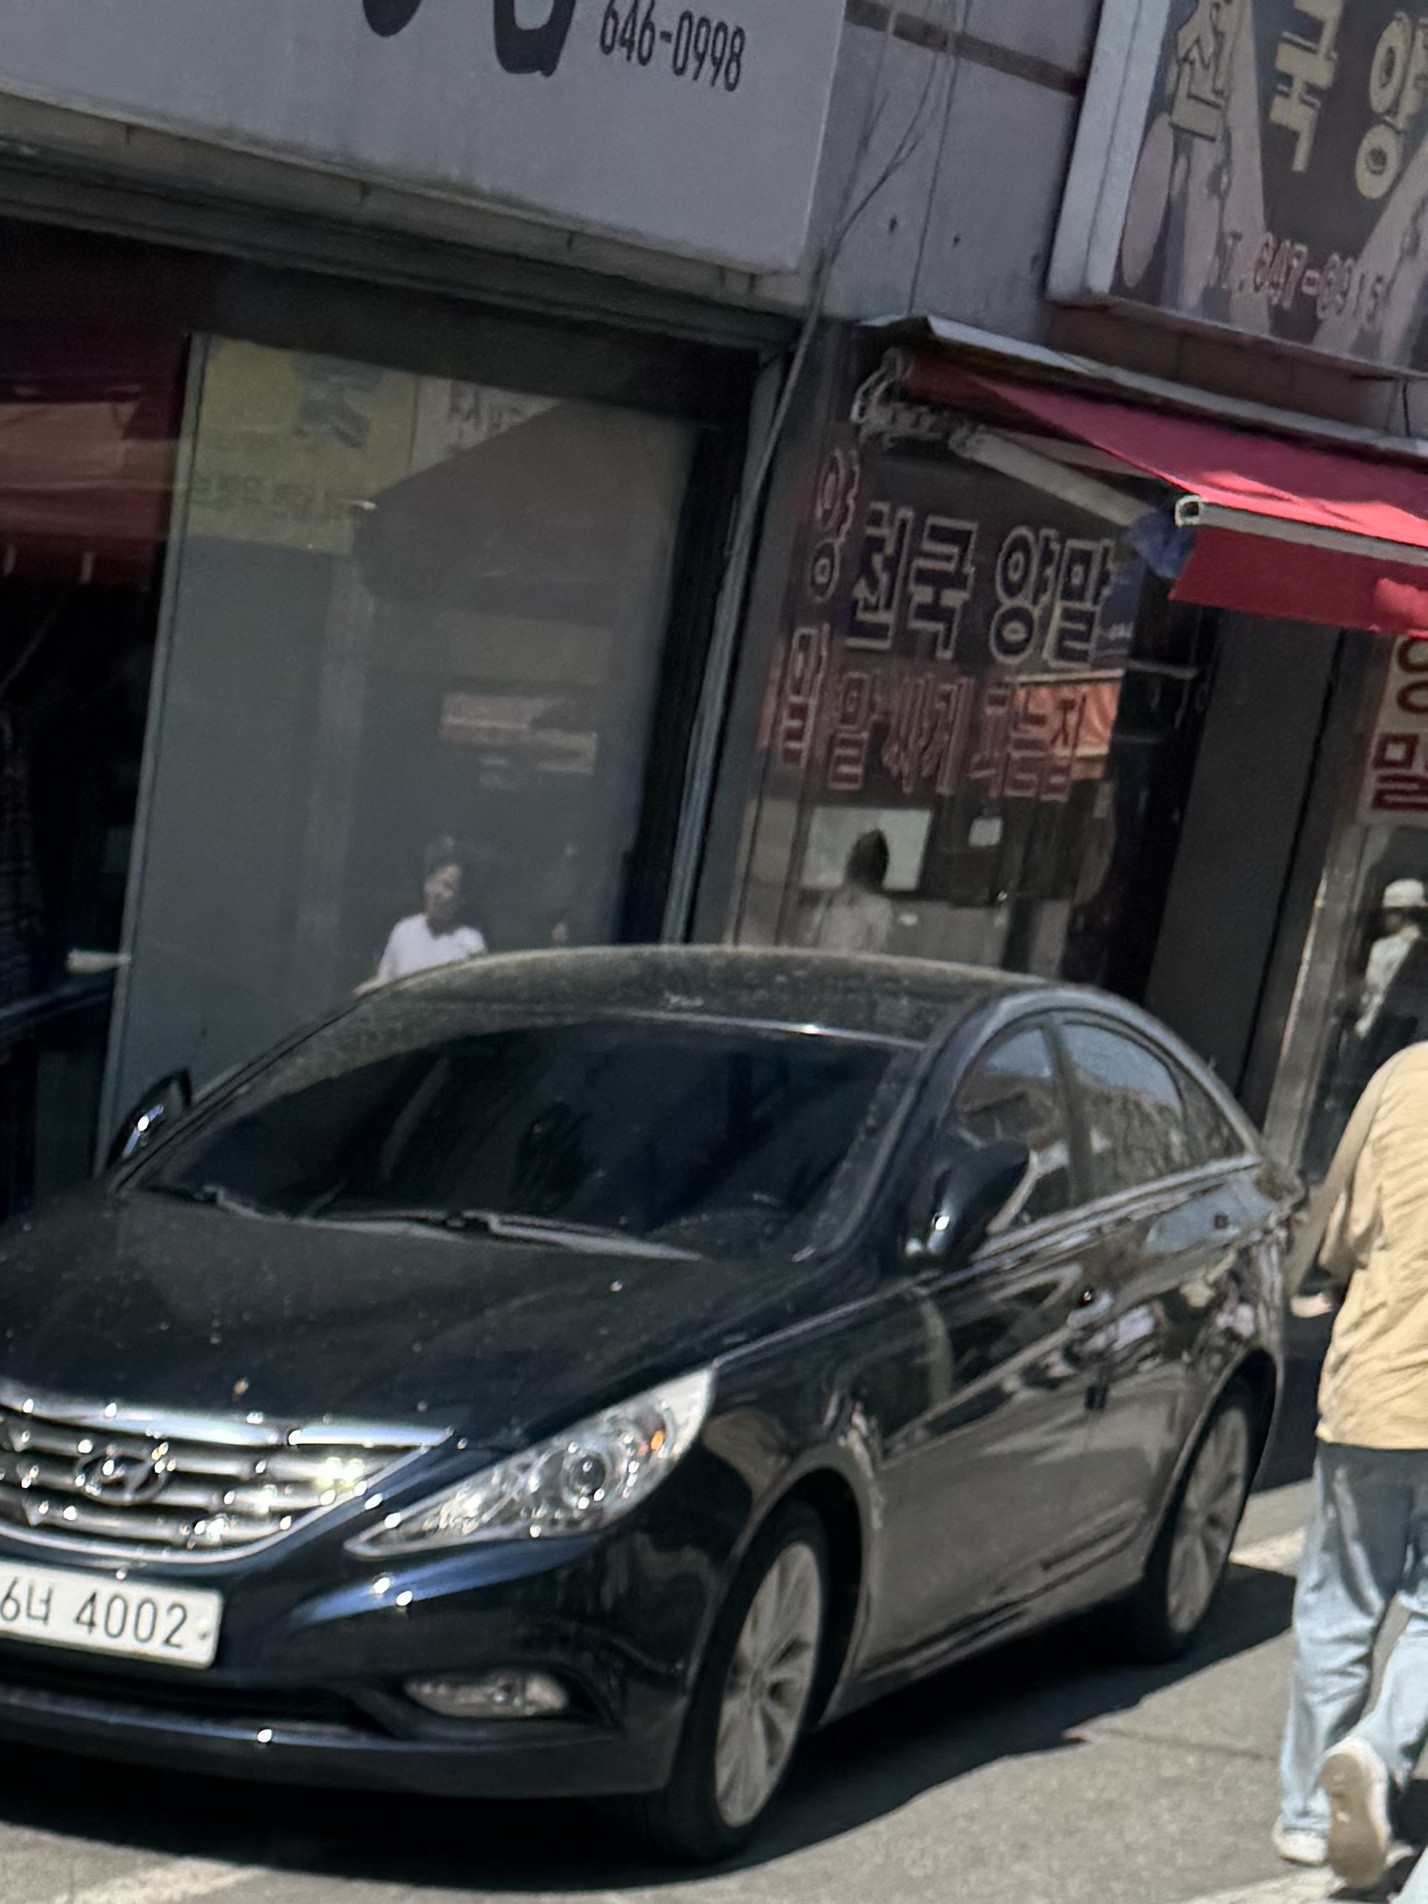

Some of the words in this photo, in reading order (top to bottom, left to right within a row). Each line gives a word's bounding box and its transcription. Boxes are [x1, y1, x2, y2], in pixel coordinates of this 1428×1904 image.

[600, 0, 745, 92] 646-0998
[988, 525, 1116, 669] 양말
[73, 1591, 188, 1650] 4002
